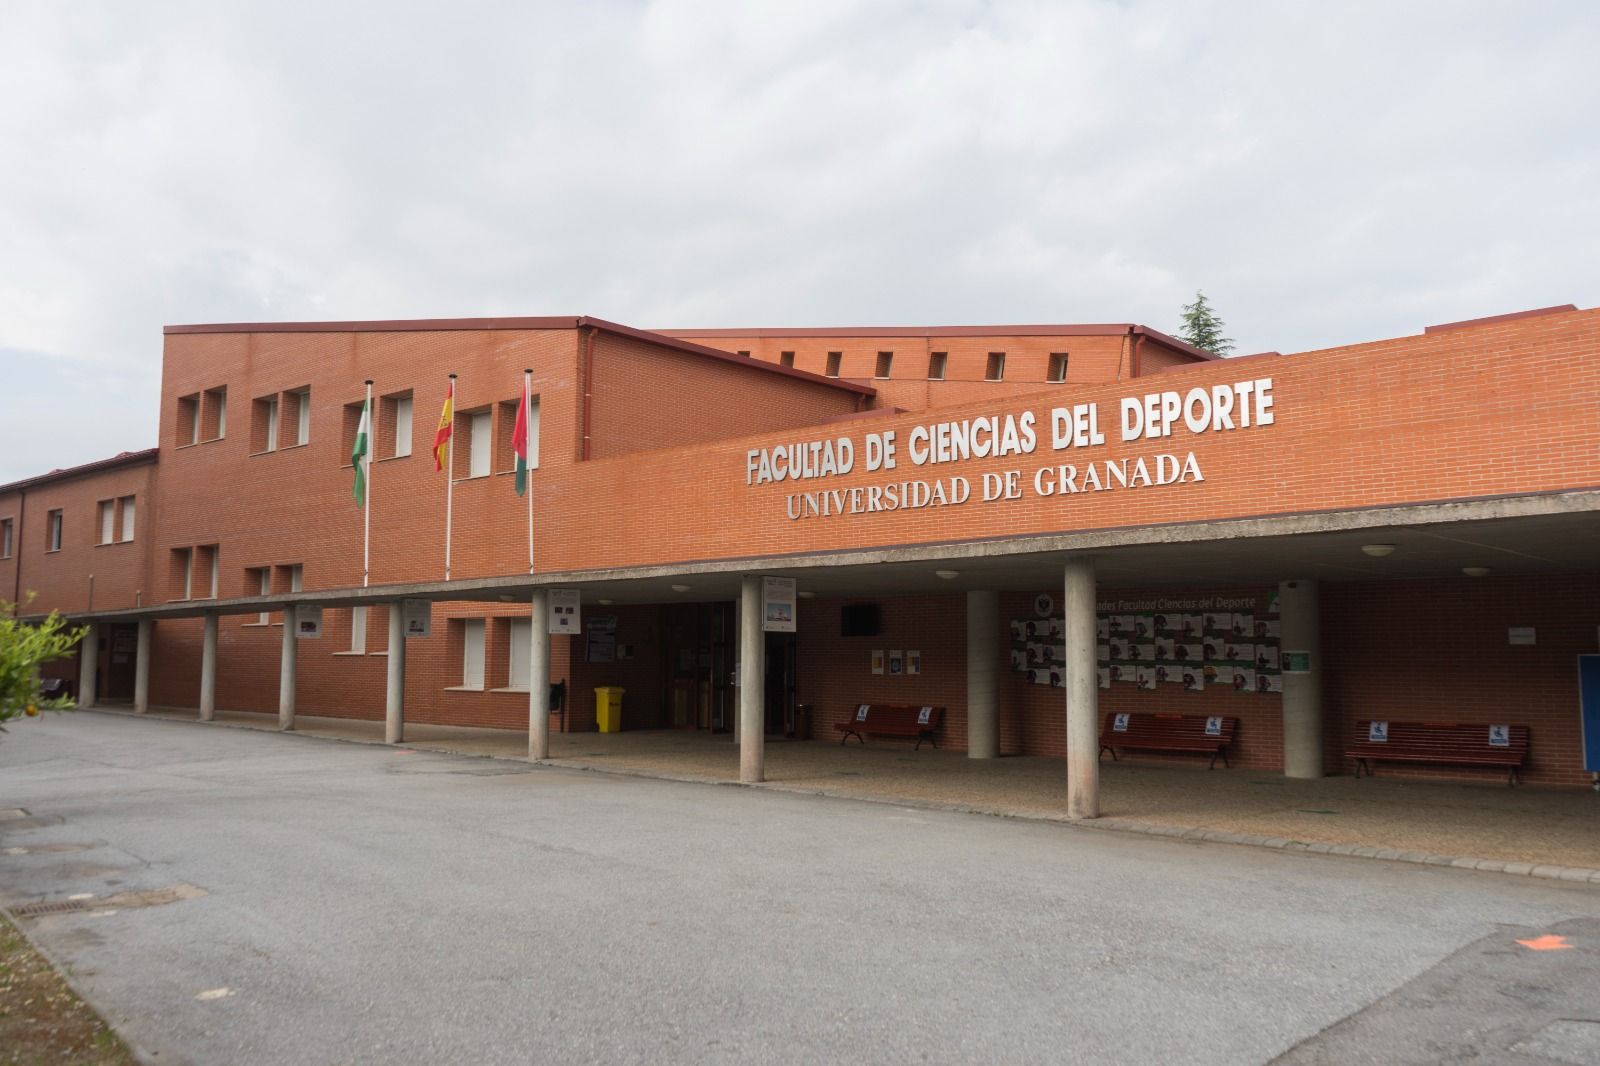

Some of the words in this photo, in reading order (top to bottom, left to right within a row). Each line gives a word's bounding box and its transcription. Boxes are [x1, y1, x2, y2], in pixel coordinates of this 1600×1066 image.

[746, 437, 854, 486] FACULTAD
[866, 430, 897, 472] DE
[908, 410, 1037, 466] CIENCIAS
[1051, 402, 1106, 451] DEL
[1120, 377, 1275, 442] DEPORTE
[785, 476, 971, 521] UNIVERSIDAD
[982, 470, 1023, 503] DE
[1033, 451, 1206, 497] GRANADA
[1118, 599, 1157, 610] Facultad
[1157, 598, 1197, 609] Ciencias
[1198, 596, 1214, 609] del
[1215, 597, 1257, 610] Deporte
